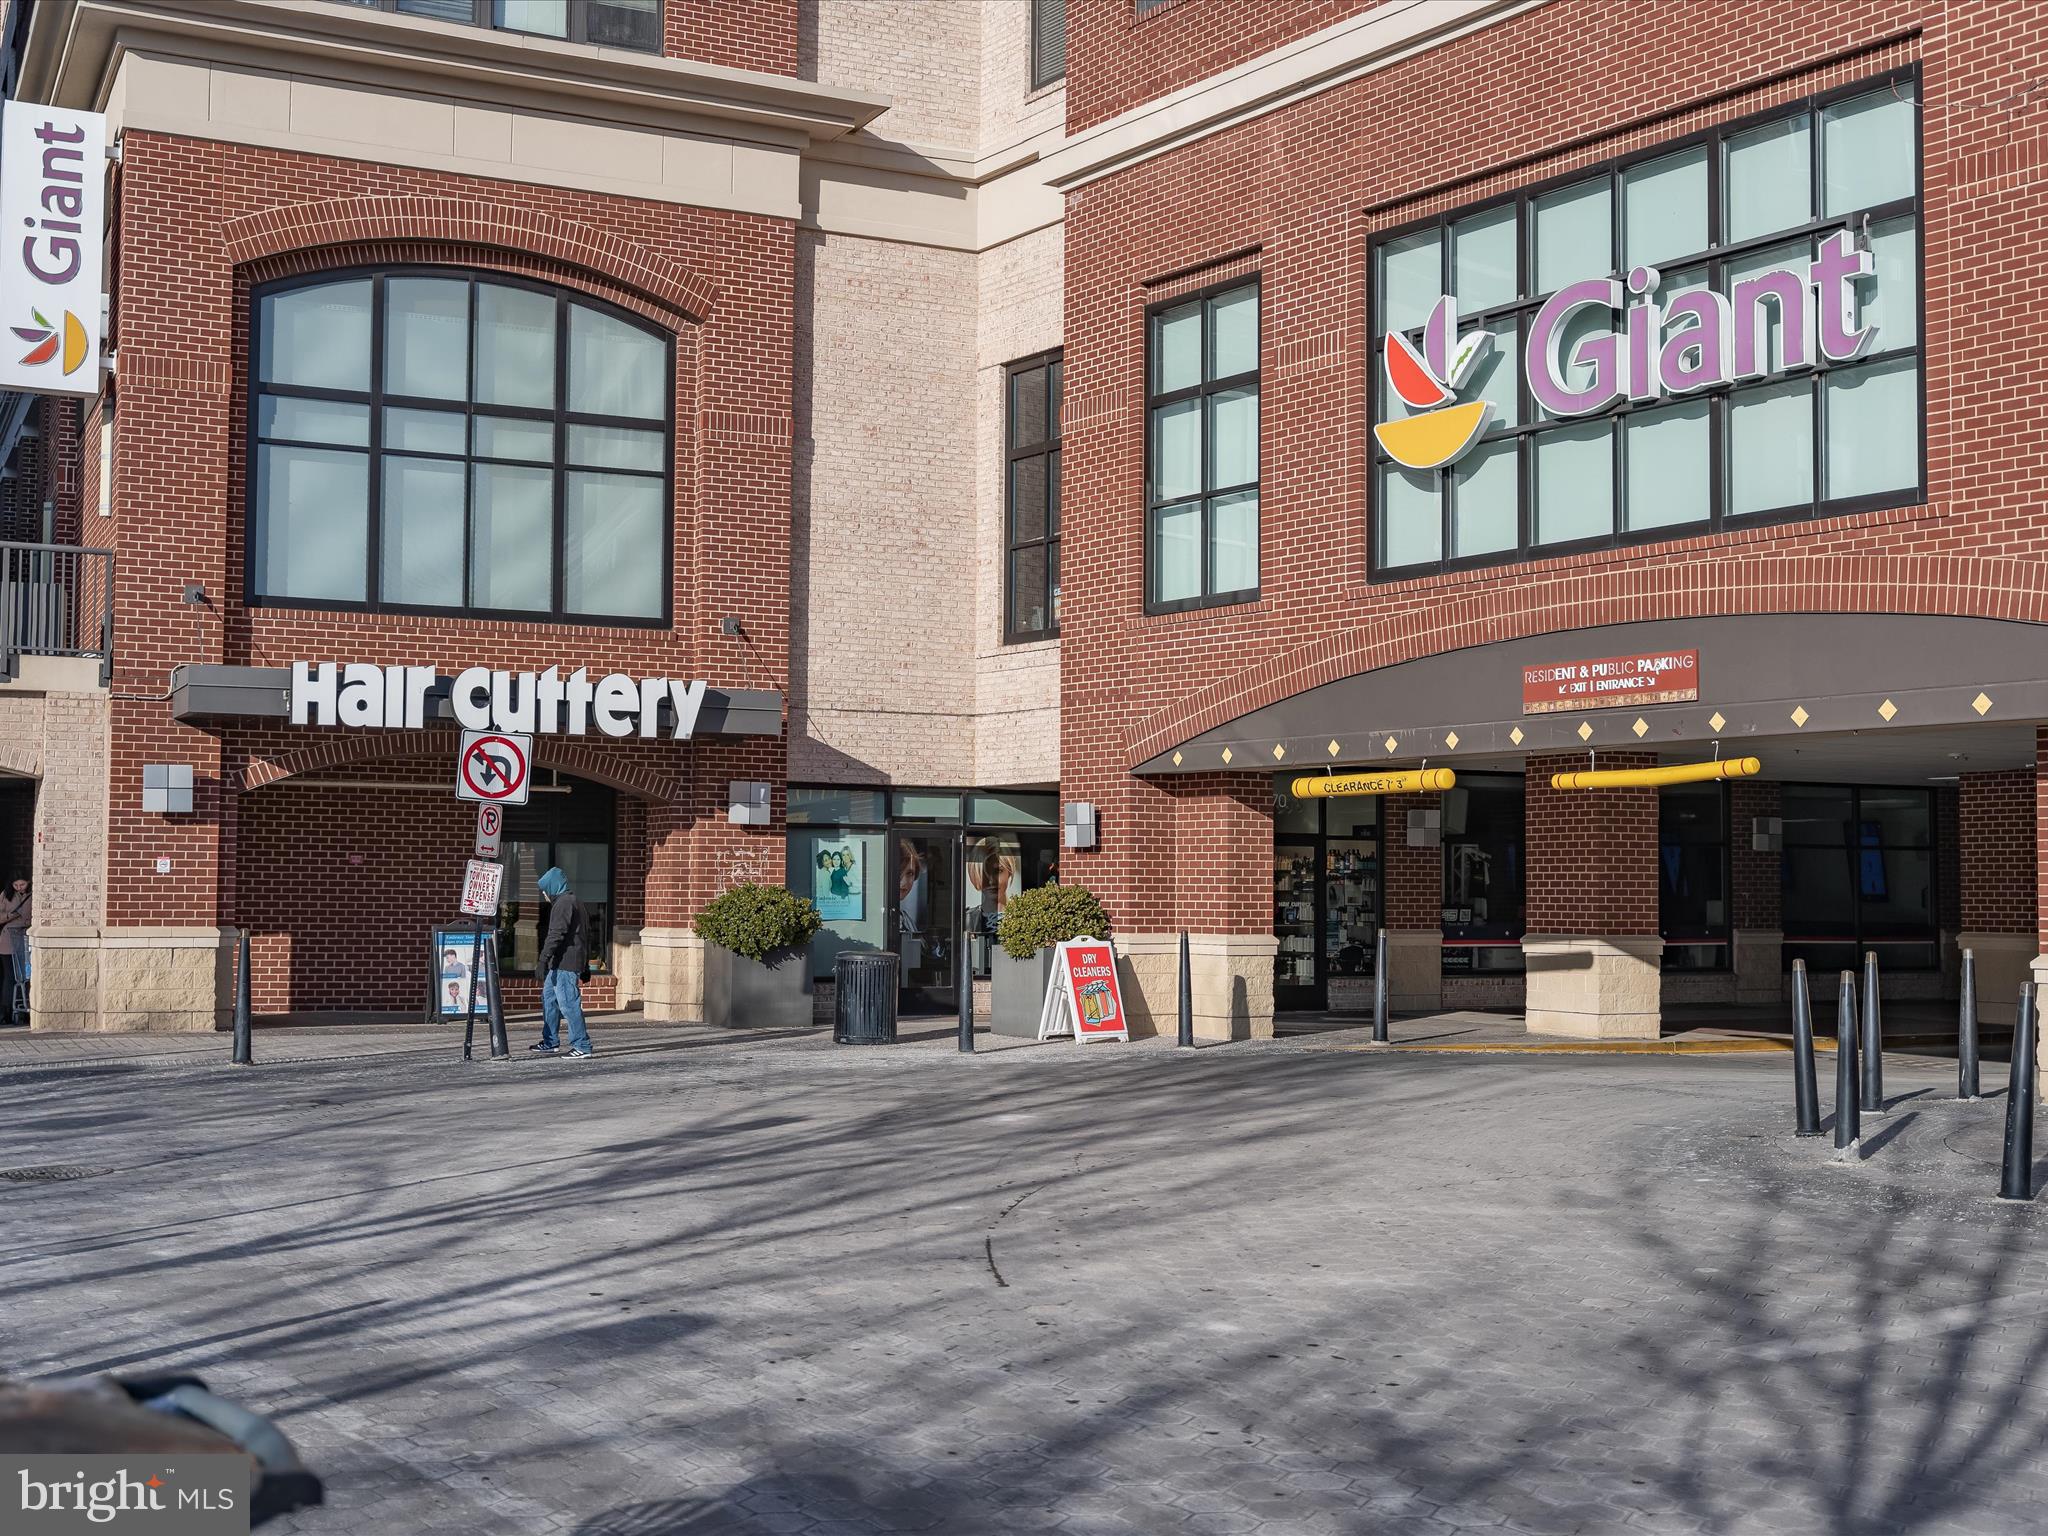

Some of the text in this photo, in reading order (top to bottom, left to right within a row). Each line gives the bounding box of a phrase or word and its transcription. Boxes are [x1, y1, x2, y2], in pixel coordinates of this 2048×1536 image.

[23, 121, 86, 285] Giant
[1525, 228, 1879, 417] Giant
[1524, 667, 1577, 683] RESIDENT
[1579, 665, 1589, 679] &
[1592, 660, 1635, 677] PUBLIC
[1570, 676, 1645, 693] EXIT ENTRANCE
[290, 660, 435, 730] Hair
[1323, 779, 1384, 793] CLEARANCE
[470, 870, 498, 884] TOWING AT
[469, 880, 496, 892] OWNER'S
[467, 889, 495, 902] EXPENSE
[1082, 954, 1097, 964] DRY
[1073, 966, 1111, 977] CLEANERS
